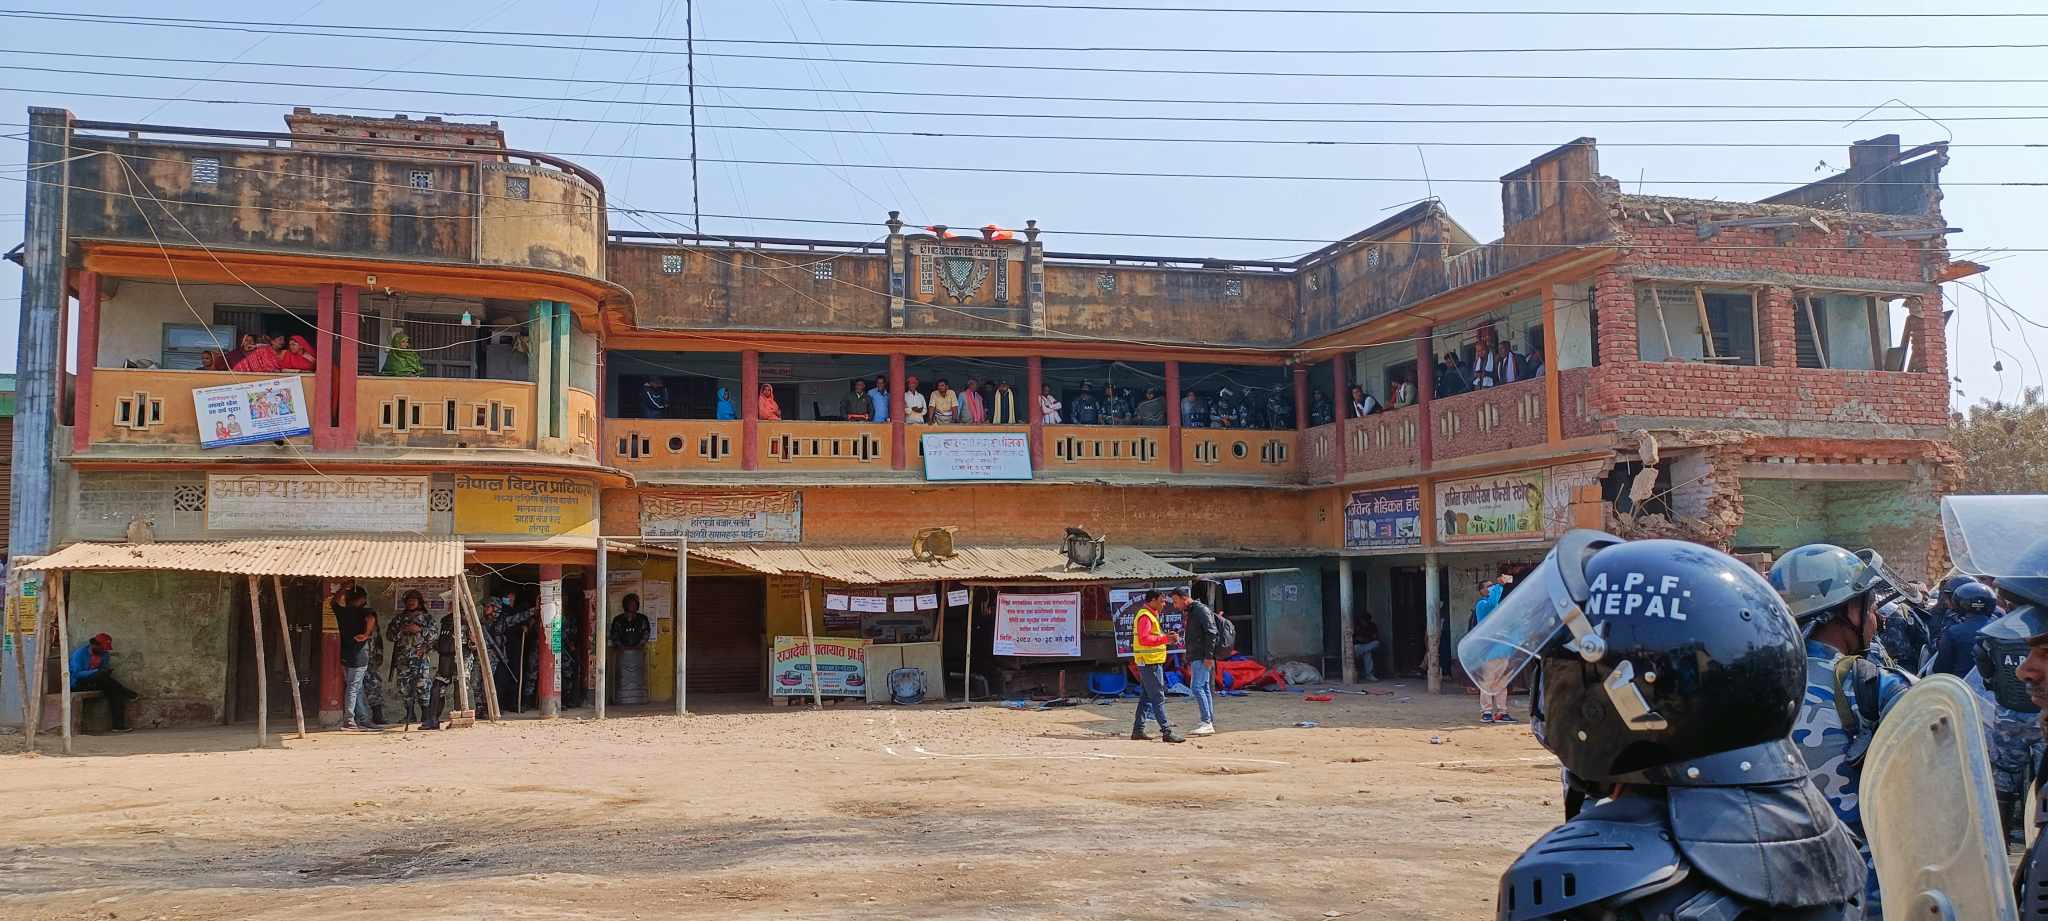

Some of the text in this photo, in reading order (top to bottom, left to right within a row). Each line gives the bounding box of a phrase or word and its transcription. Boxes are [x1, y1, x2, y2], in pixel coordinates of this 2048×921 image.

[457, 475, 503, 490] नेपाल
[507, 475, 548, 495] विद्युत
[1374, 496, 1403, 514] मेडिकल
[1589, 572, 1691, 597] A.P.F.
[1585, 593, 1687, 621] NEPAL
[777, 642, 808, 662] राजदेवी
